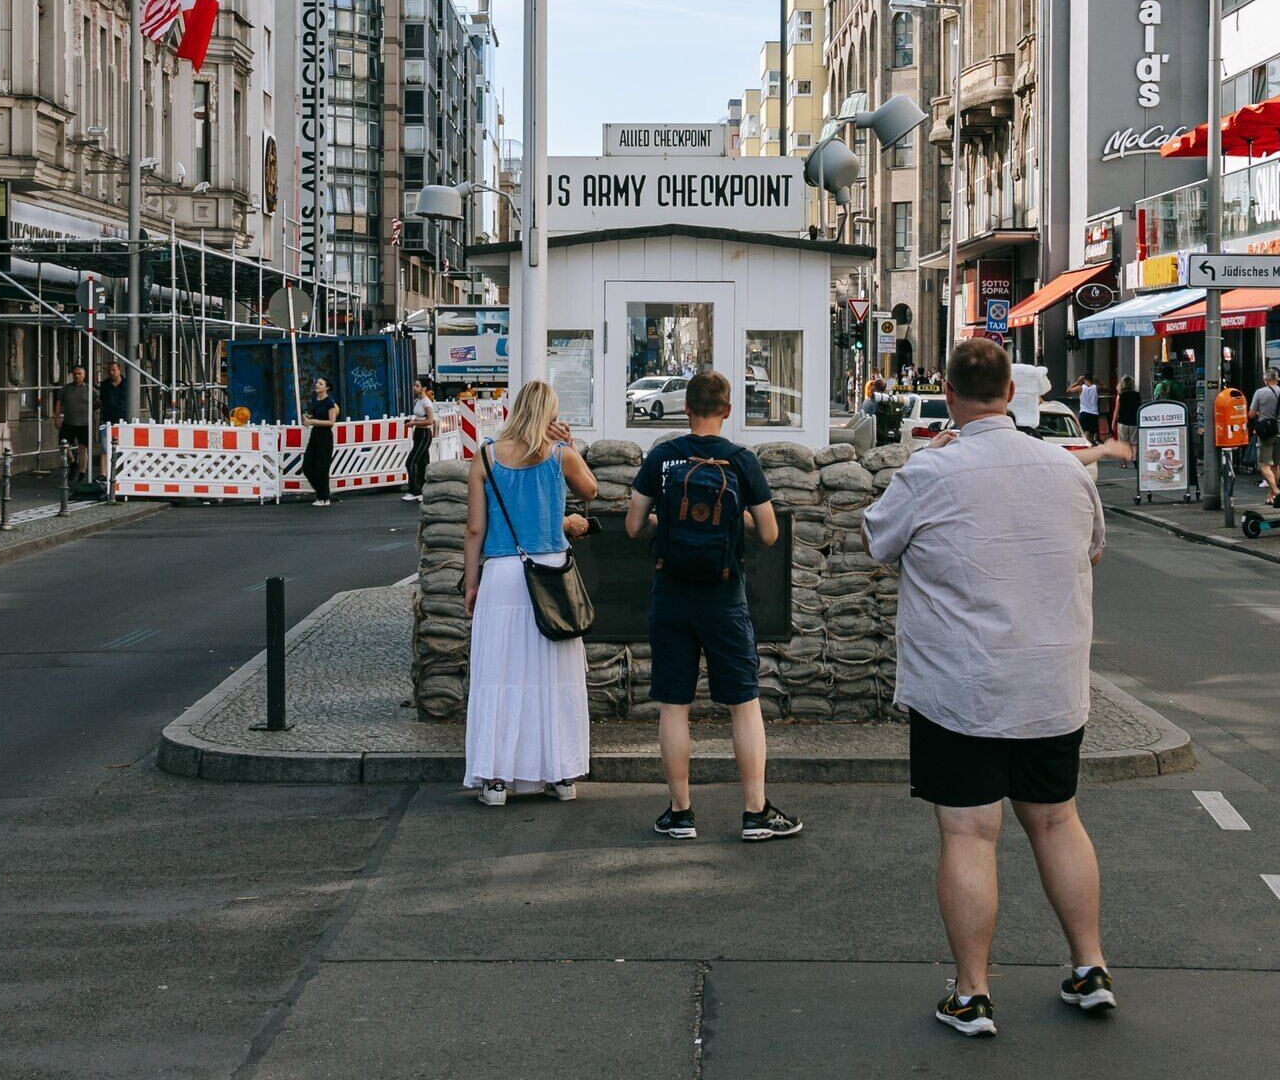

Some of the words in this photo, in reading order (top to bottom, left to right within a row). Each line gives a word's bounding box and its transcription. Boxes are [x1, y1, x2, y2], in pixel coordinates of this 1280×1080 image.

[619, 129, 650, 148] ALLIED
[653, 129, 713, 148] CHECKPOINT
[582, 174, 647, 207] ARMY
[657, 174, 794, 207] CHECKPOINT
[1222, 265, 1269, 277] Jüdisches
[981, 280, 1010, 288] SOTTO
[981, 287, 1010, 296] SOPRA
[988, 322, 1006, 330] TAXI
